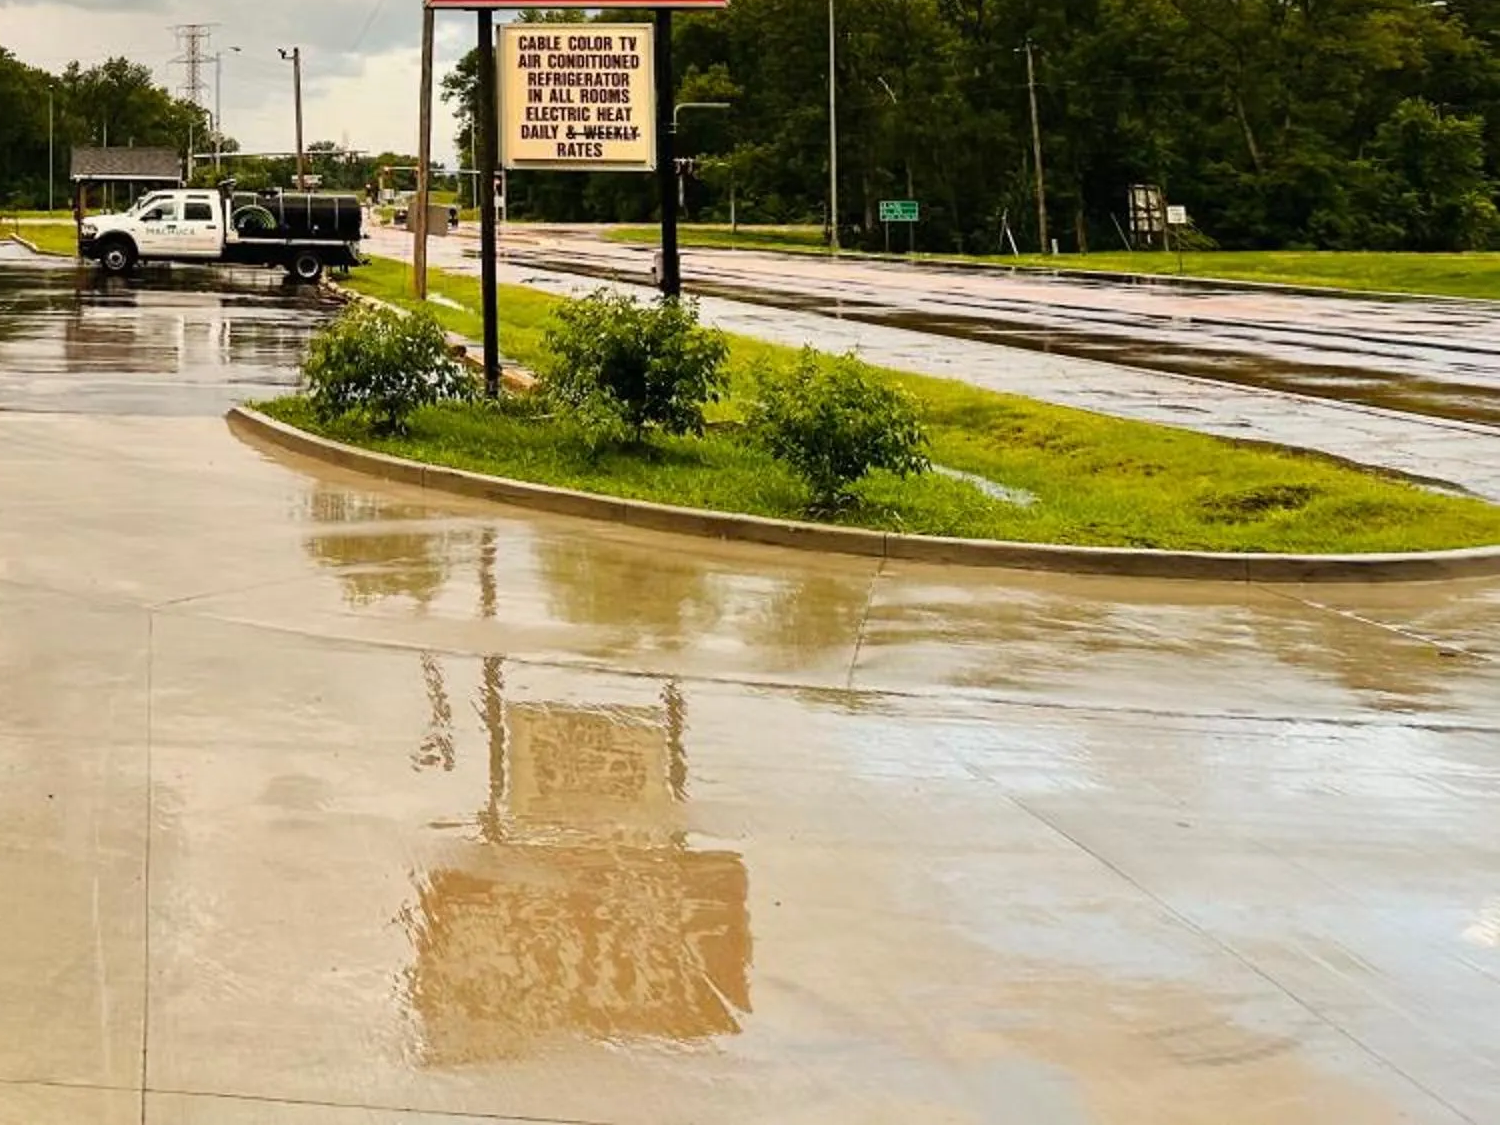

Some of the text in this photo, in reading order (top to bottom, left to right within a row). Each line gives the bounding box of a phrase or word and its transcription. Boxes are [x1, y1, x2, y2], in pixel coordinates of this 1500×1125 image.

[518, 36, 637, 51] CABLE COLOR TV
[518, 54, 639, 69] AIR CONDITIONED
[528, 72, 629, 87] REFRIGERATOR
[528, 89, 630, 104] IN ALL ROOMS
[526, 107, 632, 122] ELECTRIC HEAT
[521, 125, 639, 140] DAILY & WEEKLY
[557, 142, 602, 157] RATES
